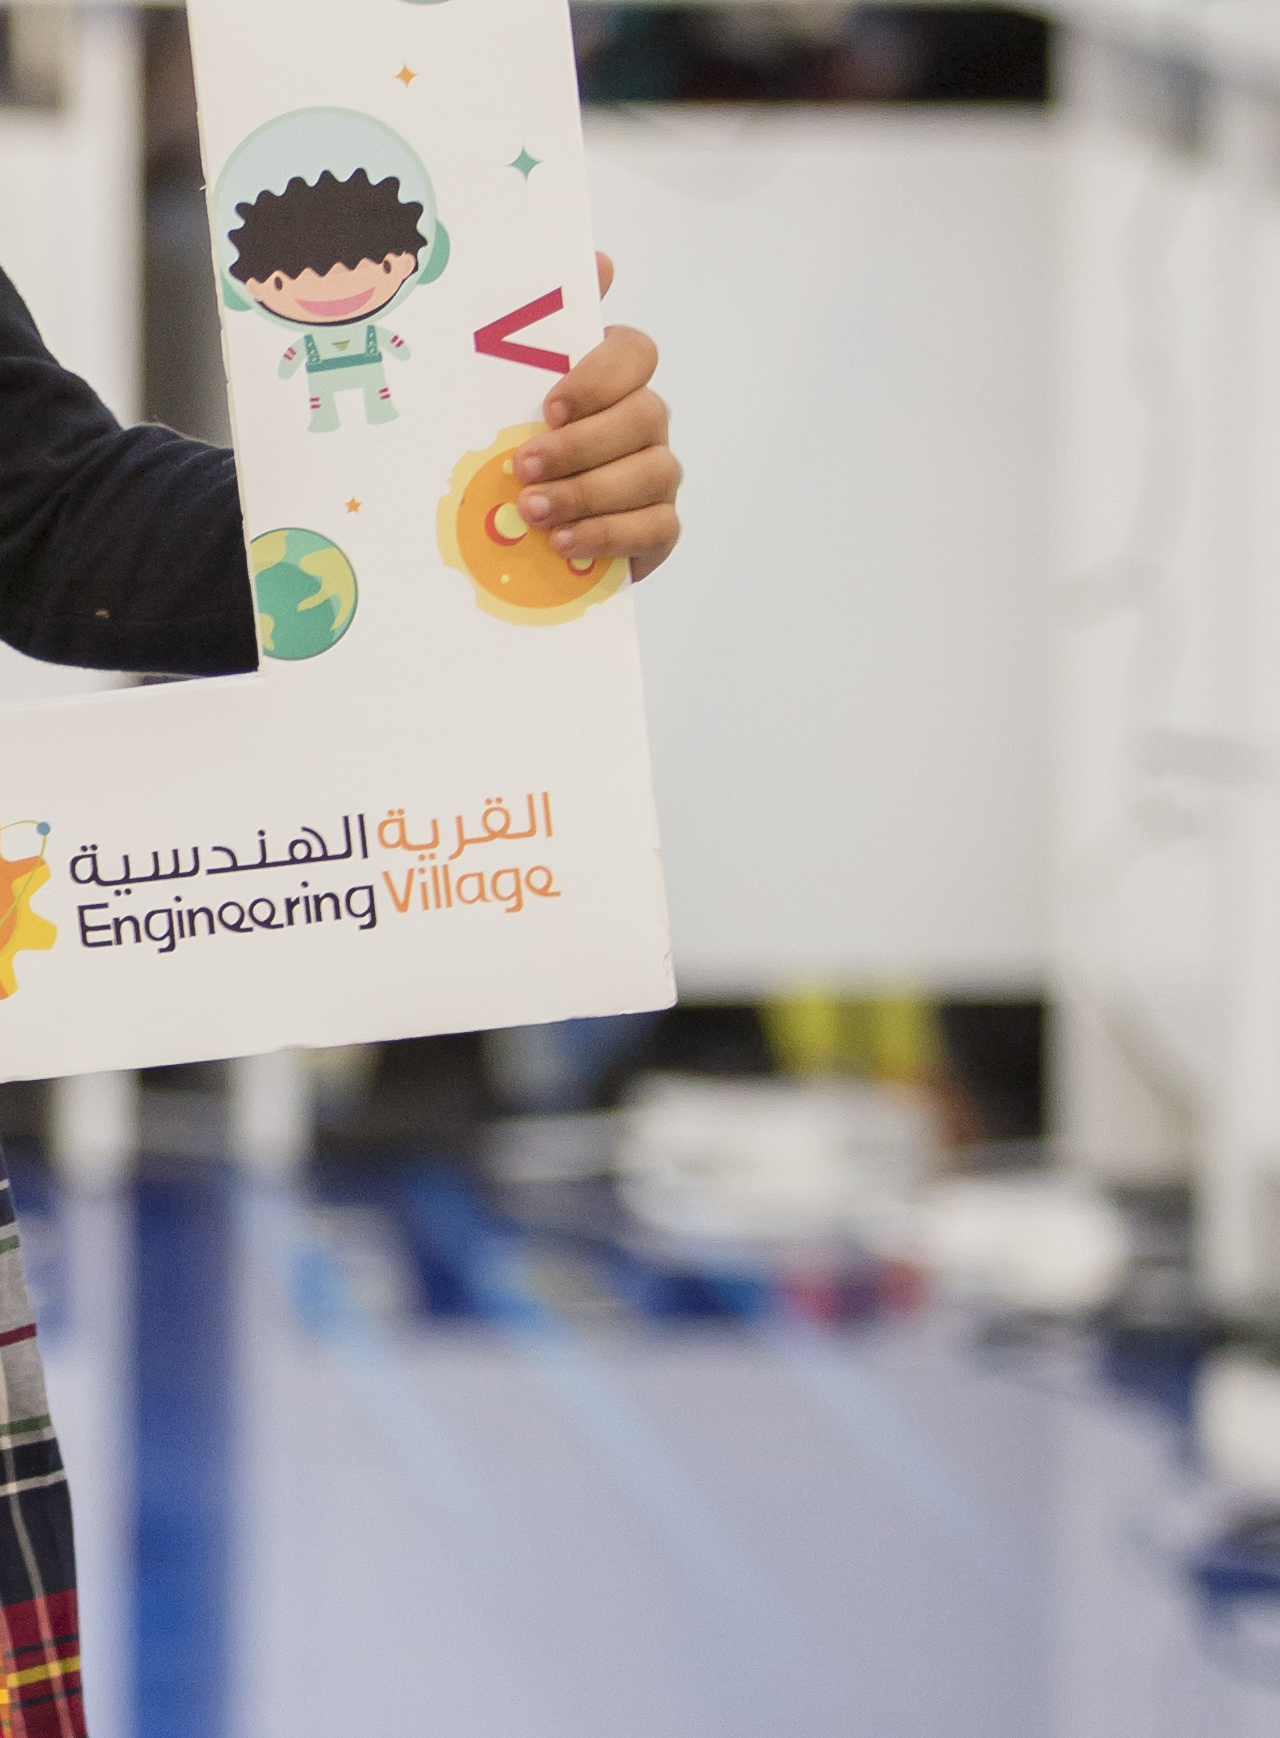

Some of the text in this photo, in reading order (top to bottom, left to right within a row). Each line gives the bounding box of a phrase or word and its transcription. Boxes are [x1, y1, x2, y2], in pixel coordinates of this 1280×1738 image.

[69, 790, 555, 897] القرية الهندسية
[76, 864, 562, 954] Engineering Village
